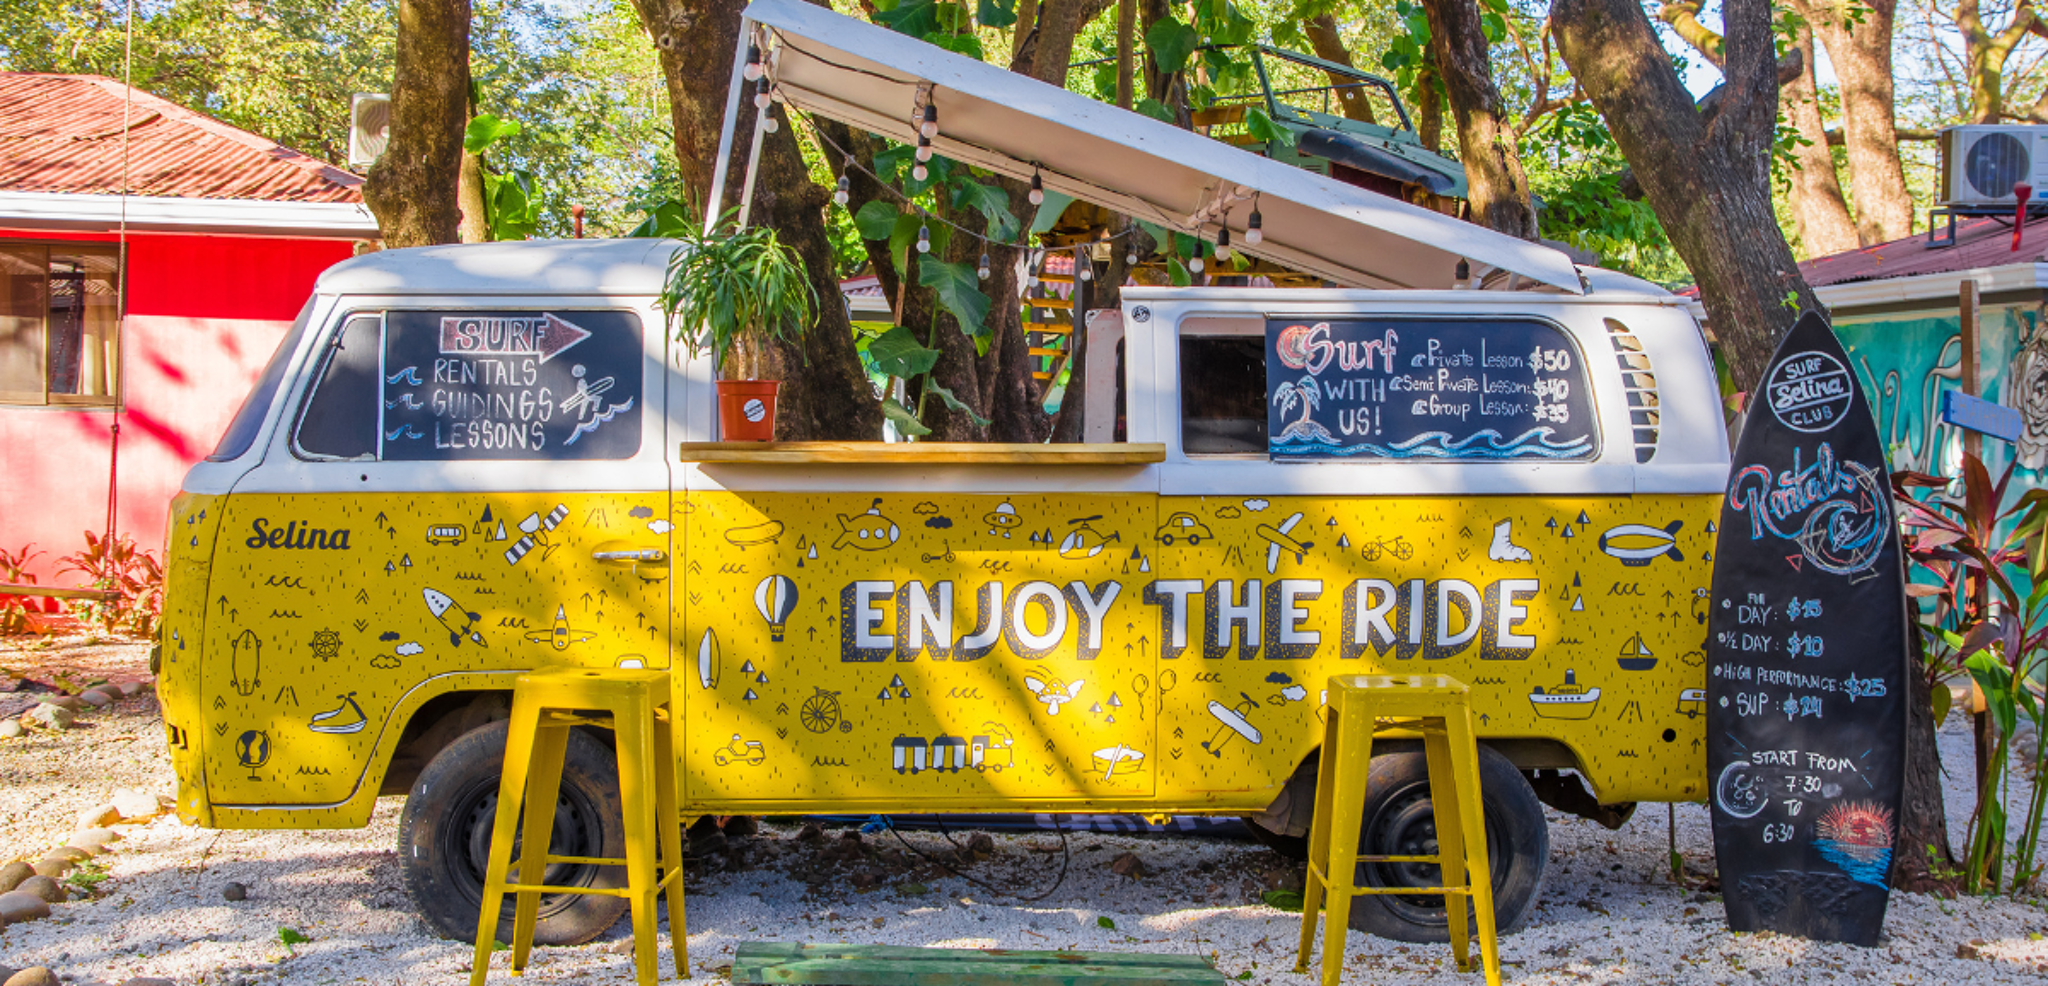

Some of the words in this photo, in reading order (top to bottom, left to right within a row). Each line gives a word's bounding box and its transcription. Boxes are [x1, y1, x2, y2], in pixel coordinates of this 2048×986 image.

[455, 318, 550, 353] SURF
[1303, 322, 1398, 375] Surf
[1428, 338, 1474, 367] Private
[1527, 345, 1571, 374] $50
[1785, 357, 1822, 380] SURF
[434, 358, 537, 386] RENTALS
[1324, 377, 1386, 403] WITH
[1402, 374, 1434, 392] Semi
[1532, 376, 1570, 402] $40
[1775, 377, 1843, 410] Selina
[432, 388, 553, 421] GUIDINGS
[1429, 394, 1471, 422] Group
[1791, 405, 1834, 426] CLUB
[435, 421, 546, 450] LESSONS
[1339, 407, 1382, 436] US!
[1729, 442, 1857, 540] Rentals
[246, 517, 351, 551] Selina
[841, 578, 1123, 663] ENJOY
[1142, 578, 1324, 661] THE
[1340, 578, 1540, 662] RIDE
[1786, 596, 1823, 621] $15
[1786, 630, 1824, 659] $10
[1844, 671, 1887, 703] $25
[1752, 750, 1798, 767] START
[1805, 752, 1857, 773] FROM
[1785, 775, 1822, 793] 7:30
[1763, 823, 1795, 843] 6:30
